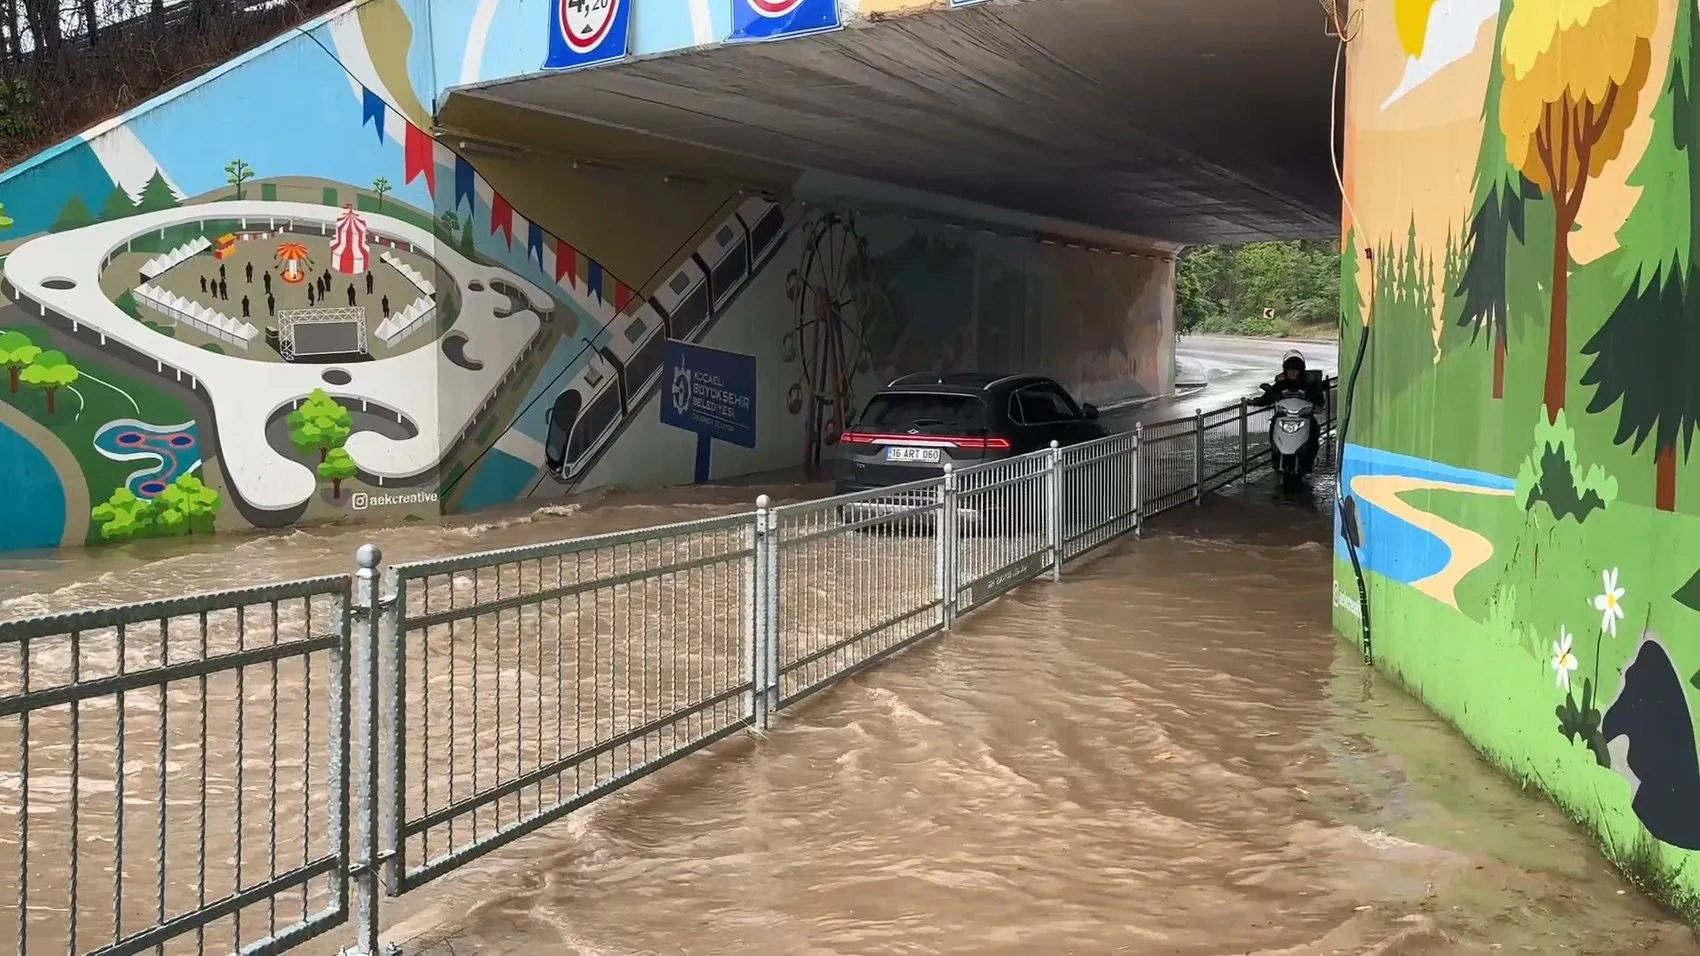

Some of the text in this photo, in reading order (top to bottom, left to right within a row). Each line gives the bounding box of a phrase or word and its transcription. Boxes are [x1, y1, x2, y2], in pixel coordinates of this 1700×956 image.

[892, 448, 939, 459] 16 ART 060
[369, 491, 438, 506] aekcreative
